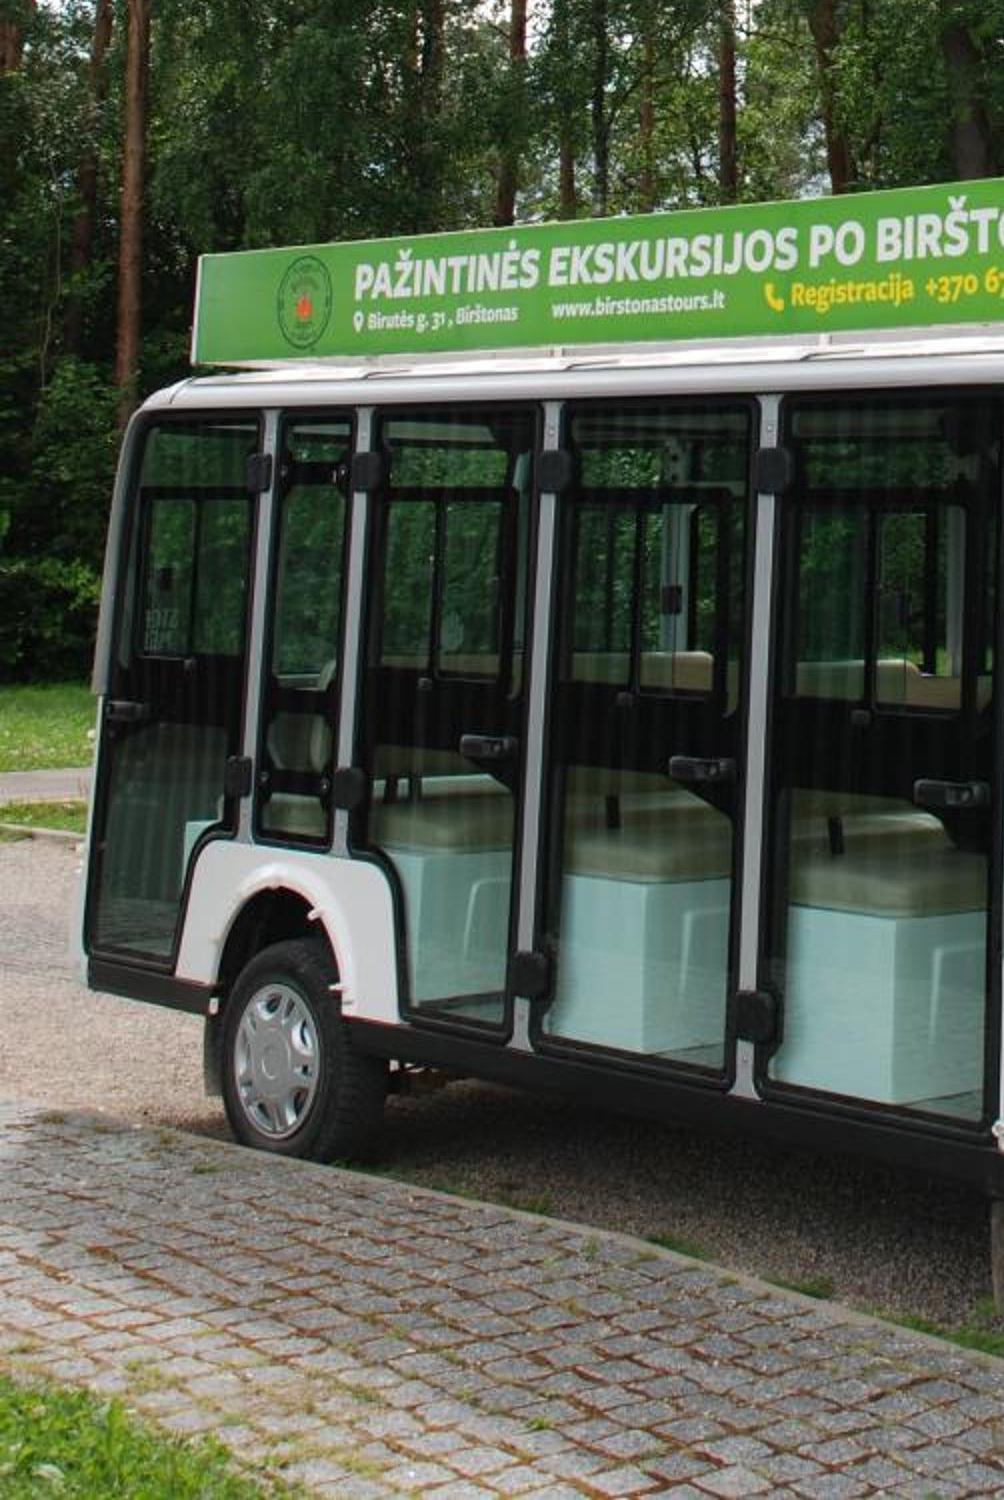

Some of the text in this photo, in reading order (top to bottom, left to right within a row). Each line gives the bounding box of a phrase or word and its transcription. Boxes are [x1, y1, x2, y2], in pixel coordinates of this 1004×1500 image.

[354, 239, 540, 301] PAŽINTINĖS
[547, 227, 799, 287] EKSKURSIJOS
[809, 220, 866, 269] PO
[552, 289, 726, 319] www.birstonastours.lt
[791, 273, 914, 312] Registracija
[925, 273, 977, 302] +370
[367, 313, 415, 331] Birutės
[416, 315, 429, 333] g.
[455, 304, 519, 325] Birštonas
